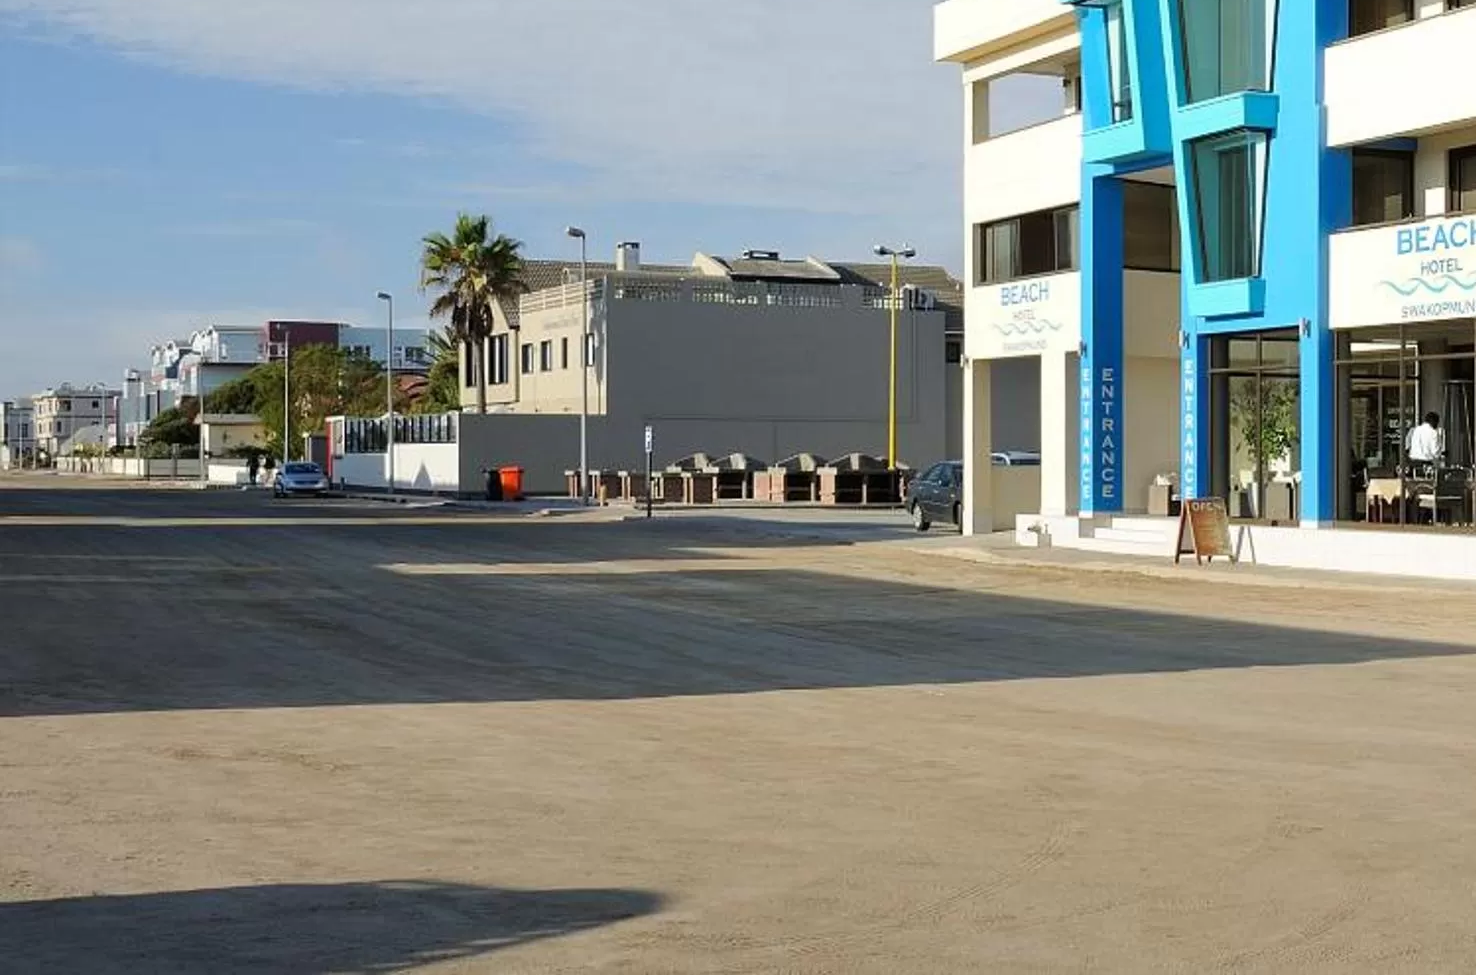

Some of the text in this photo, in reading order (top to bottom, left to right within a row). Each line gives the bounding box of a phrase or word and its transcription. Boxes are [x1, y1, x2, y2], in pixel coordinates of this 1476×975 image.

[1000, 280, 1049, 306] BEACH
[1420, 257, 1463, 275] HOTEL
[1083, 368, 1091, 499] ENTRANCE
[1102, 368, 1115, 498] ENTRANCE
[1183, 359, 1195, 499] ENTRANCE
